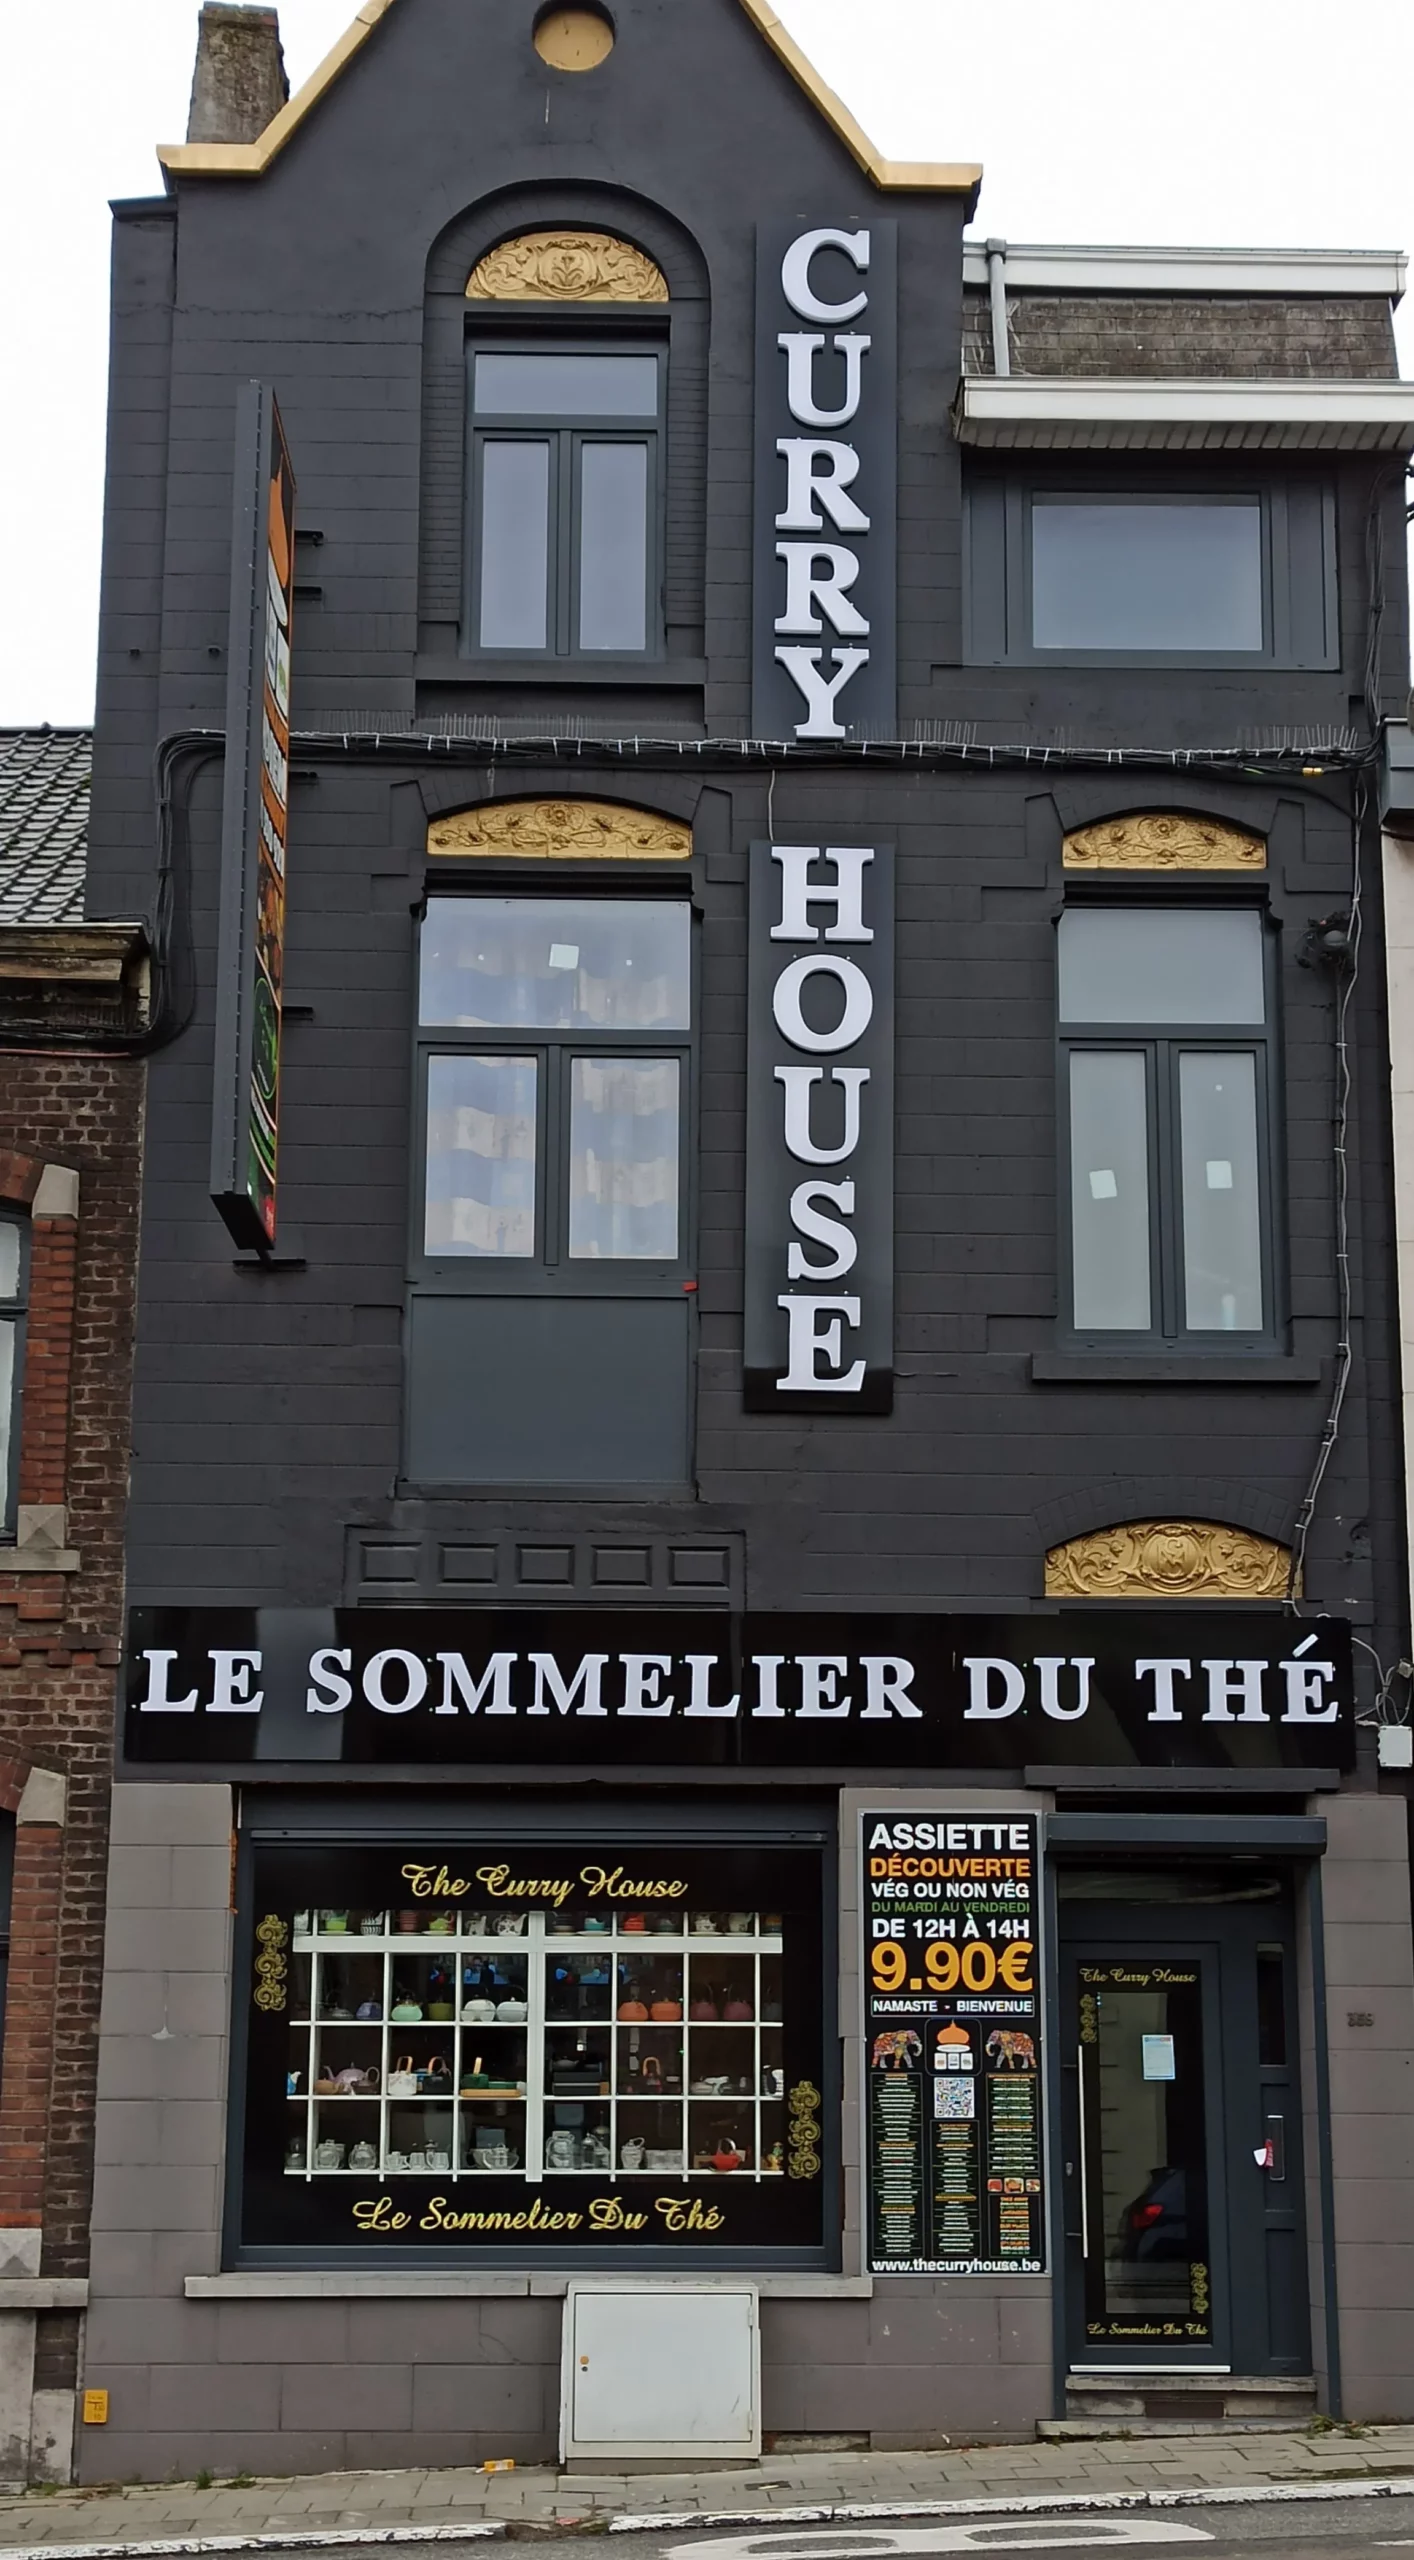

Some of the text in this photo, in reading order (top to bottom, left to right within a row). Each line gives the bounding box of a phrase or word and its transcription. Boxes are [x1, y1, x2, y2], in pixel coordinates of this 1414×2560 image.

[770, 228, 874, 1392] CURRY HOUSE
[140, 1633, 1340, 1722] LE SOMMELIER DU THÉ
[868, 1823, 1030, 1851] ASSIETTE
[870, 1853, 1032, 1878] DÉCOUVERTE
[401, 1864, 689, 1908] The Curry House
[871, 1879, 1030, 1899] VÉG OU NON VÉG
[871, 1901, 1030, 1914] DU MARDI AU VENDREDI
[872, 1912, 1030, 1939] DE 12H À 14H
[871, 1941, 1034, 1992] 9.90€
[1080, 1968, 1197, 1986] The Curry House
[873, 2000, 938, 2012] NAMASTE
[956, 2000, 1033, 2013] BIENVENUE
[352, 2196, 726, 2231] Le Sommelier Du Thé
[871, 2257, 1041, 2274] www.thecurryhouse.be
[1087, 2322, 1106, 2335] Le
[1108, 2322, 1163, 2335] Sommelier
